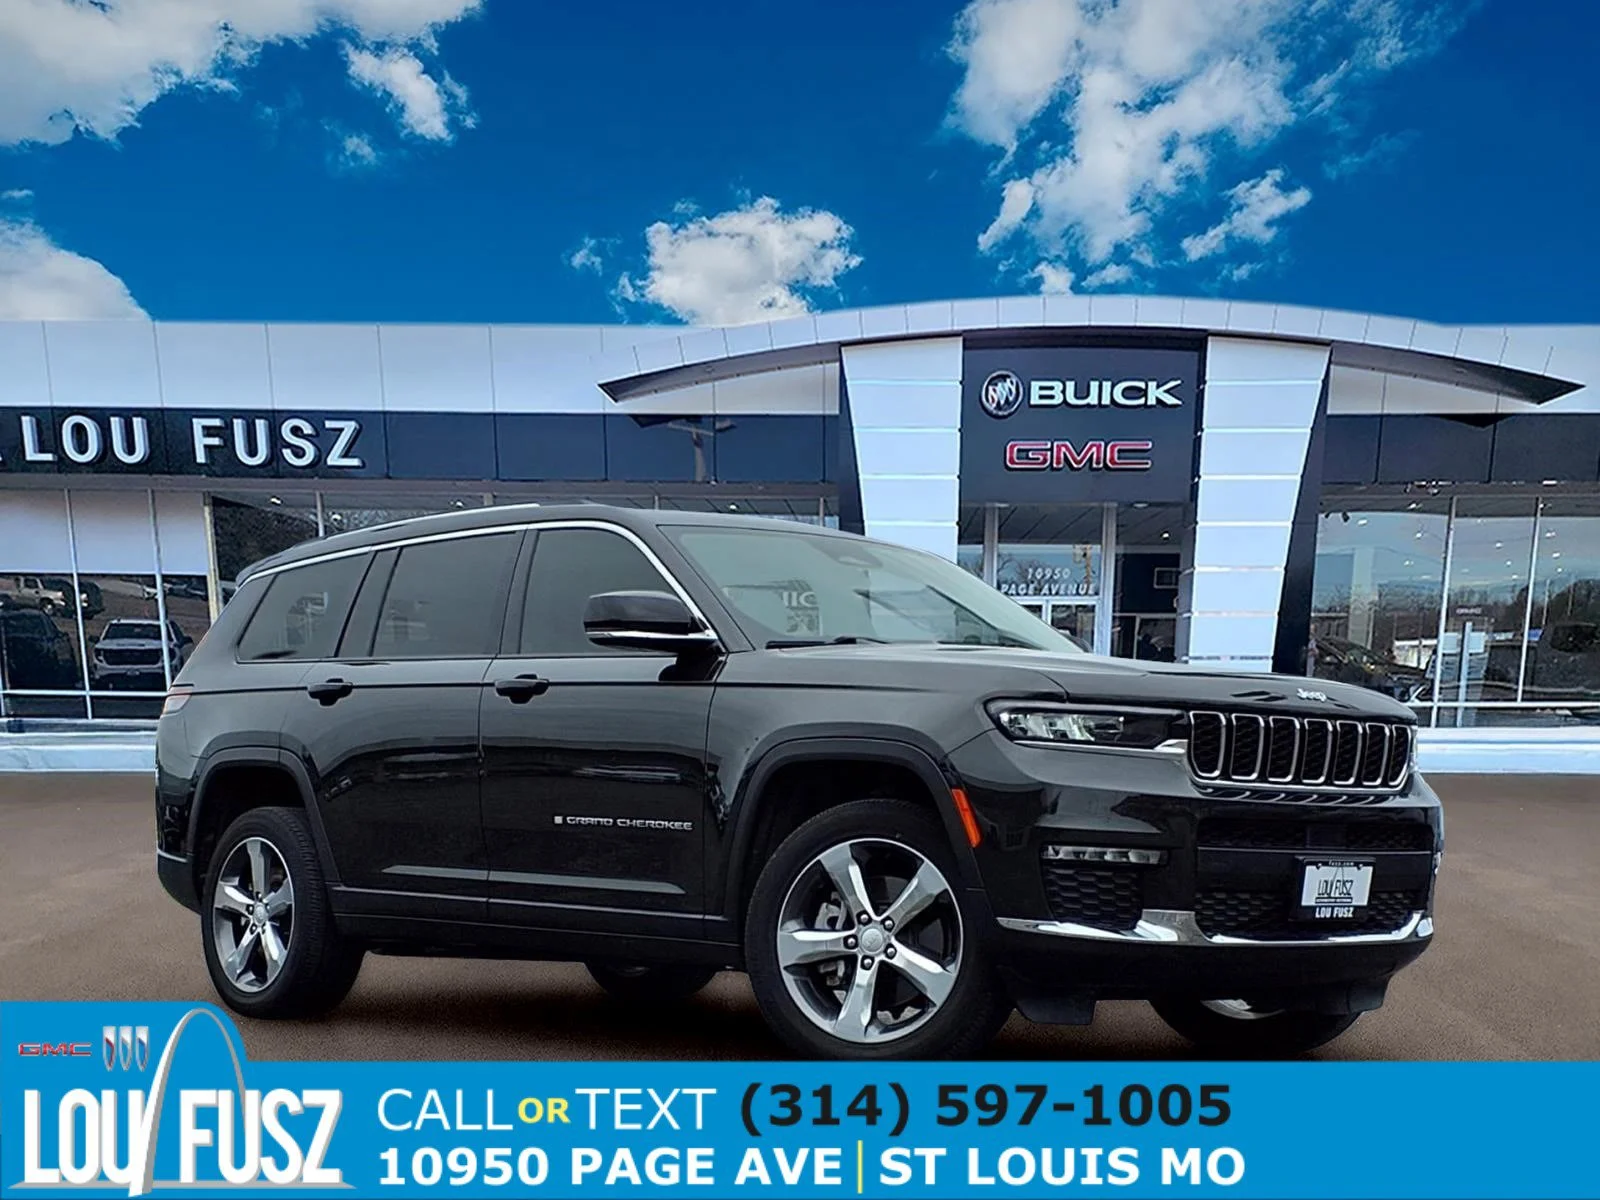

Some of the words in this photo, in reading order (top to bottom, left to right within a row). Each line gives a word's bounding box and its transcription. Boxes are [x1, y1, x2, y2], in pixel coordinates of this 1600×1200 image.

[1029, 379, 1183, 407] BUICK
[20, 414, 150, 464] LOU
[191, 417, 364, 468] FUSZ
[1005, 440, 1153, 470] GMC
[1027, 567, 1071, 580] 10950
[1001, 583, 1035, 596] PAGE
[1041, 583, 1096, 596] AVENUE
[1296, 687, 1327, 702] Jeep
[566, 816, 614, 826] GRAND
[616, 818, 693, 830] CHEROKEE
[1315, 906, 1332, 918] LOU
[1333, 906, 1354, 918] FUSZ
